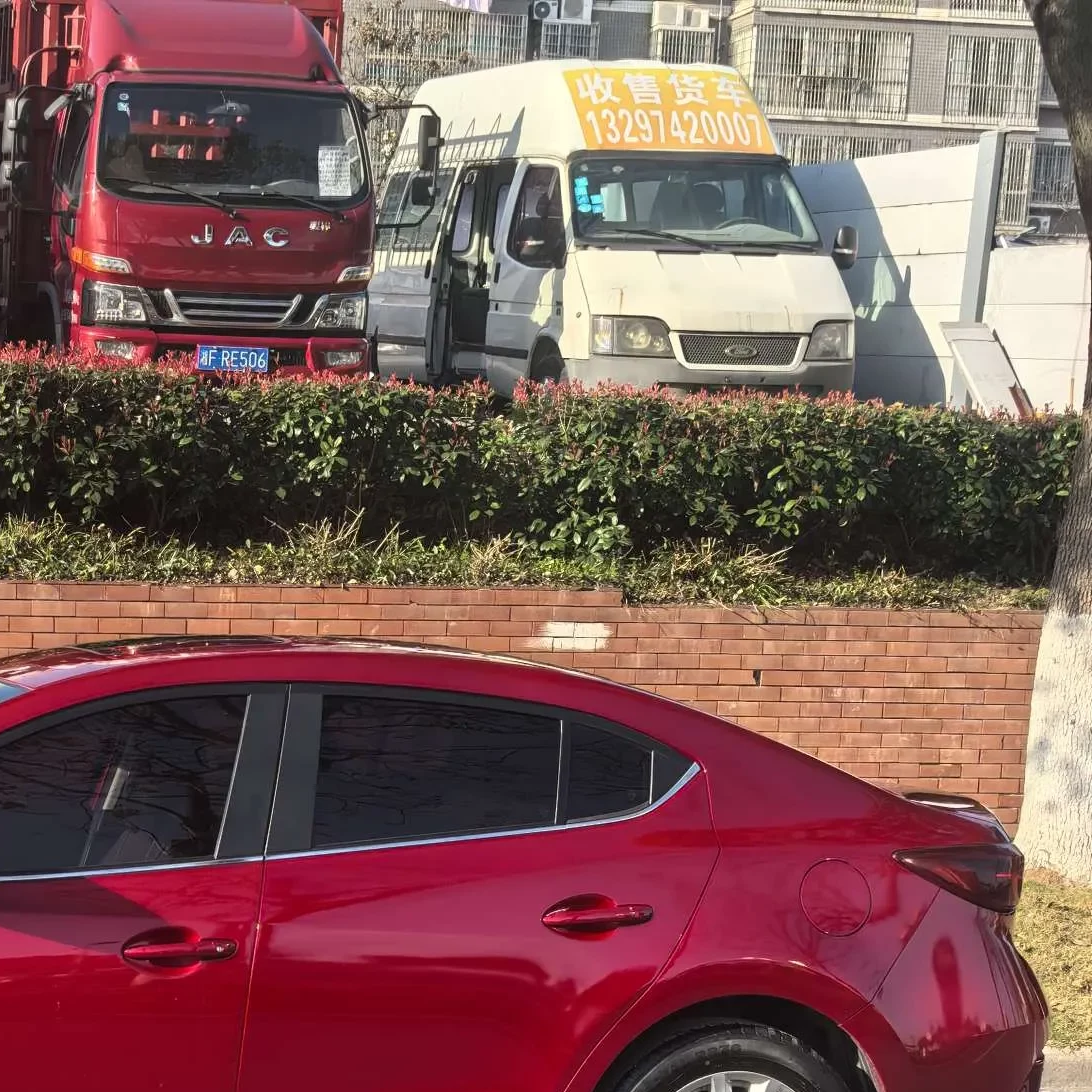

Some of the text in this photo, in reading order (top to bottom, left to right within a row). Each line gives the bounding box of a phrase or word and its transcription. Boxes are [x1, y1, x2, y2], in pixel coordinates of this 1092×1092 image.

[576, 72, 752, 107] 收售货车
[587, 109, 763, 147] 13297420007
[190, 223, 289, 248] JAC
